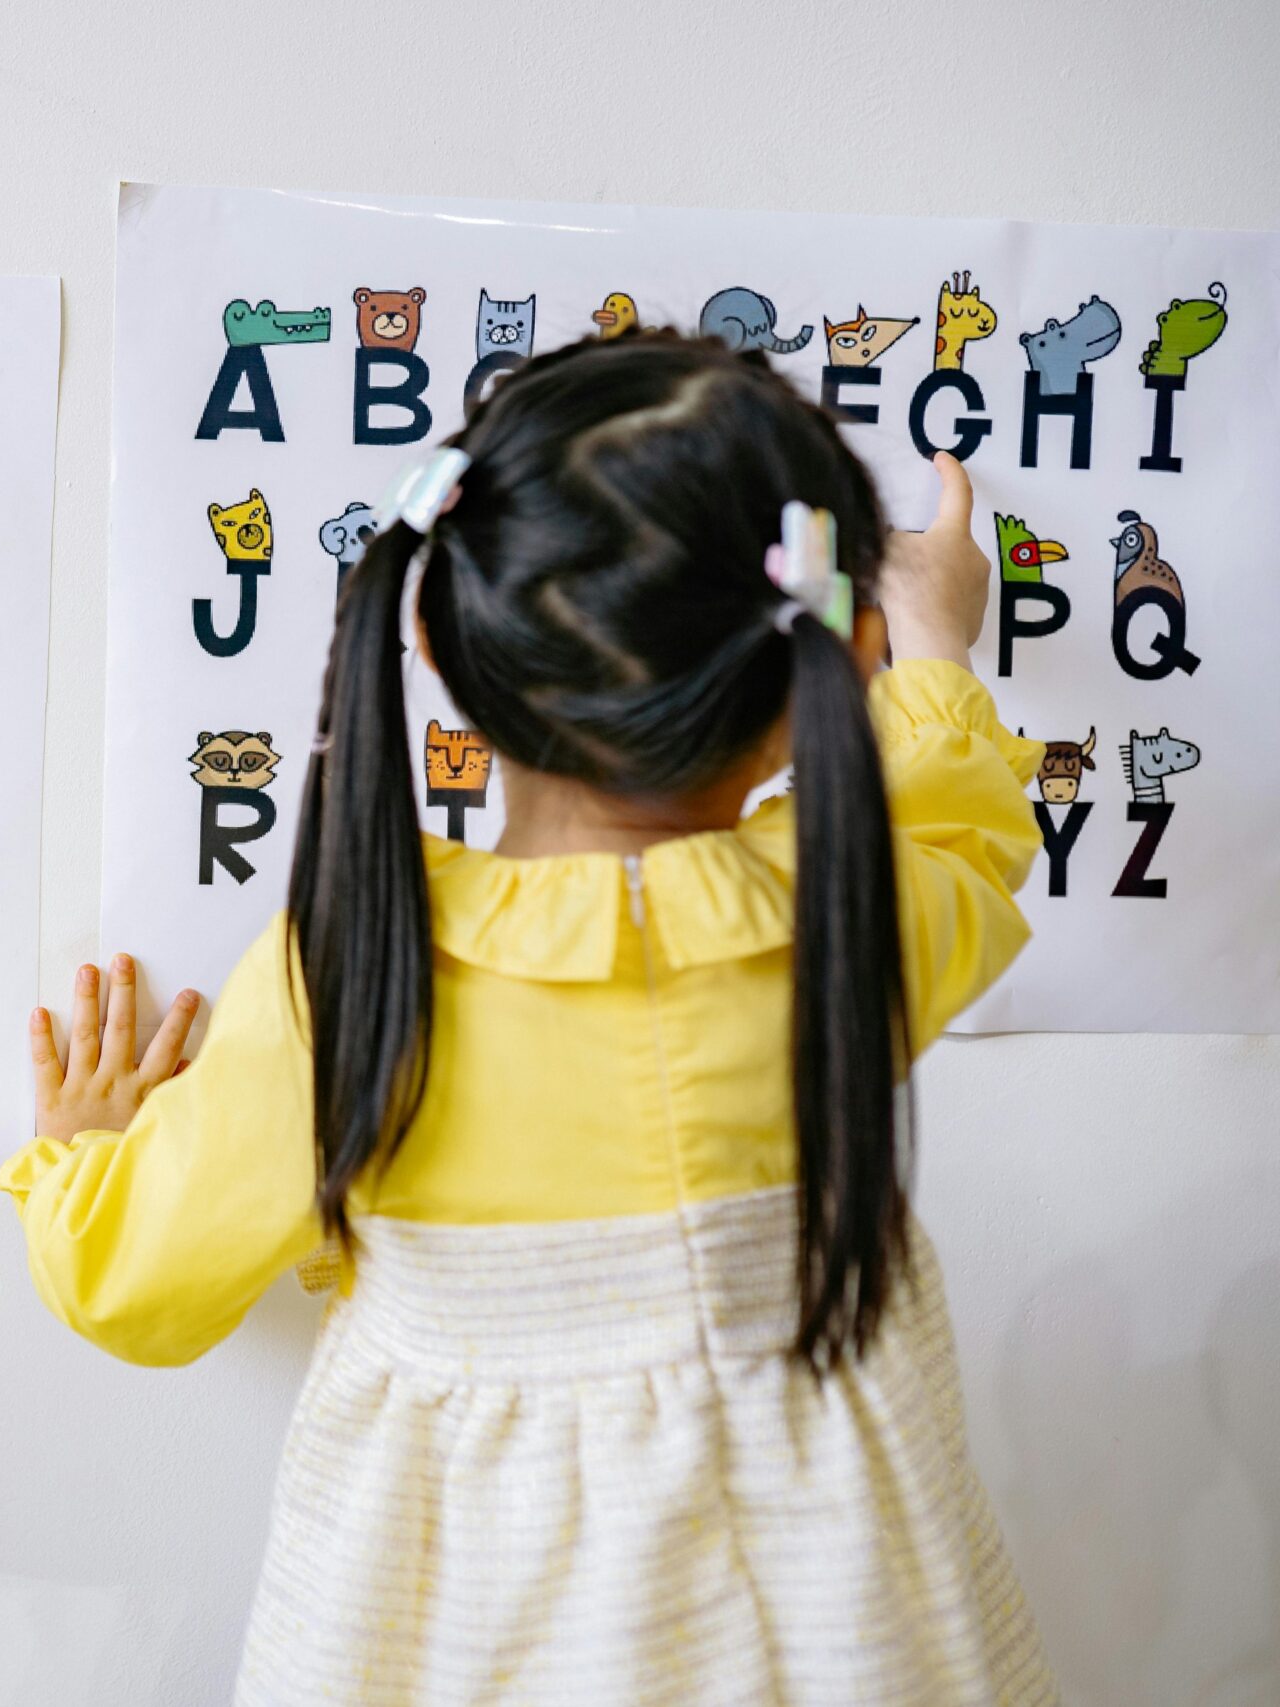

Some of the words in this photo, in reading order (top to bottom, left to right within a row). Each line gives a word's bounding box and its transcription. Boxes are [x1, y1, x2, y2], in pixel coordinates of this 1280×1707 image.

[194, 345, 286, 443] A
[353, 347, 433, 445] B
[908, 368, 993, 463] G
[1020, 371, 1094, 469] H
[1139, 375, 1187, 472] I
[192, 558, 272, 657] J
[998, 581, 1070, 677] P
[1111, 585, 1201, 681] Q
[198, 786, 277, 886] R
[426, 789, 486, 840] T
[1033, 801, 1095, 898] Y
[1110, 802, 1176, 899] Z
